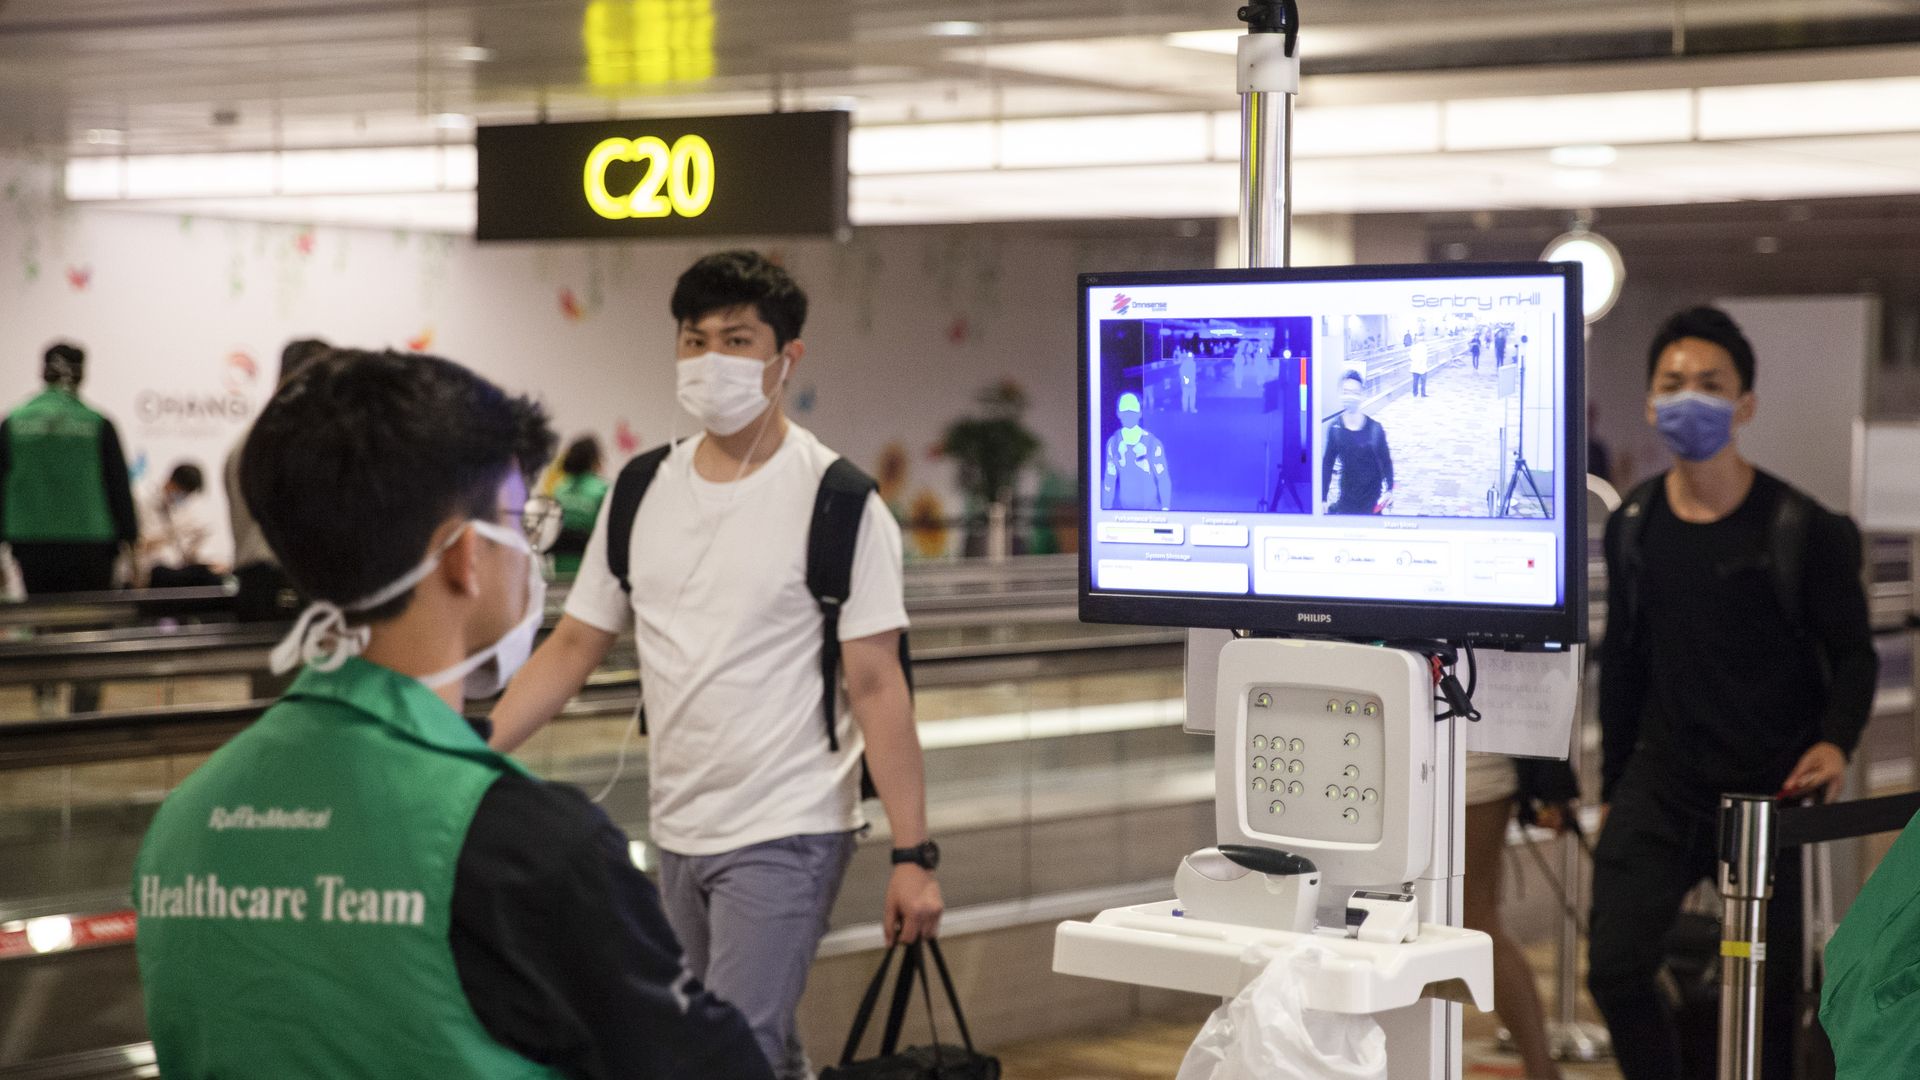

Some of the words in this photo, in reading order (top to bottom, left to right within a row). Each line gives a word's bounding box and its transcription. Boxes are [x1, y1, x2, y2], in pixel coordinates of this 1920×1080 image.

[583, 134, 715, 220] C20
[1411, 294, 1493, 311] Sentry
[1297, 613, 1332, 623] PHILIPS
[1345, 706, 1352, 714] f2
[1364, 707, 1371, 716] f3
[139, 873, 308, 920] Healthcare
[316, 874, 425, 925] Team
